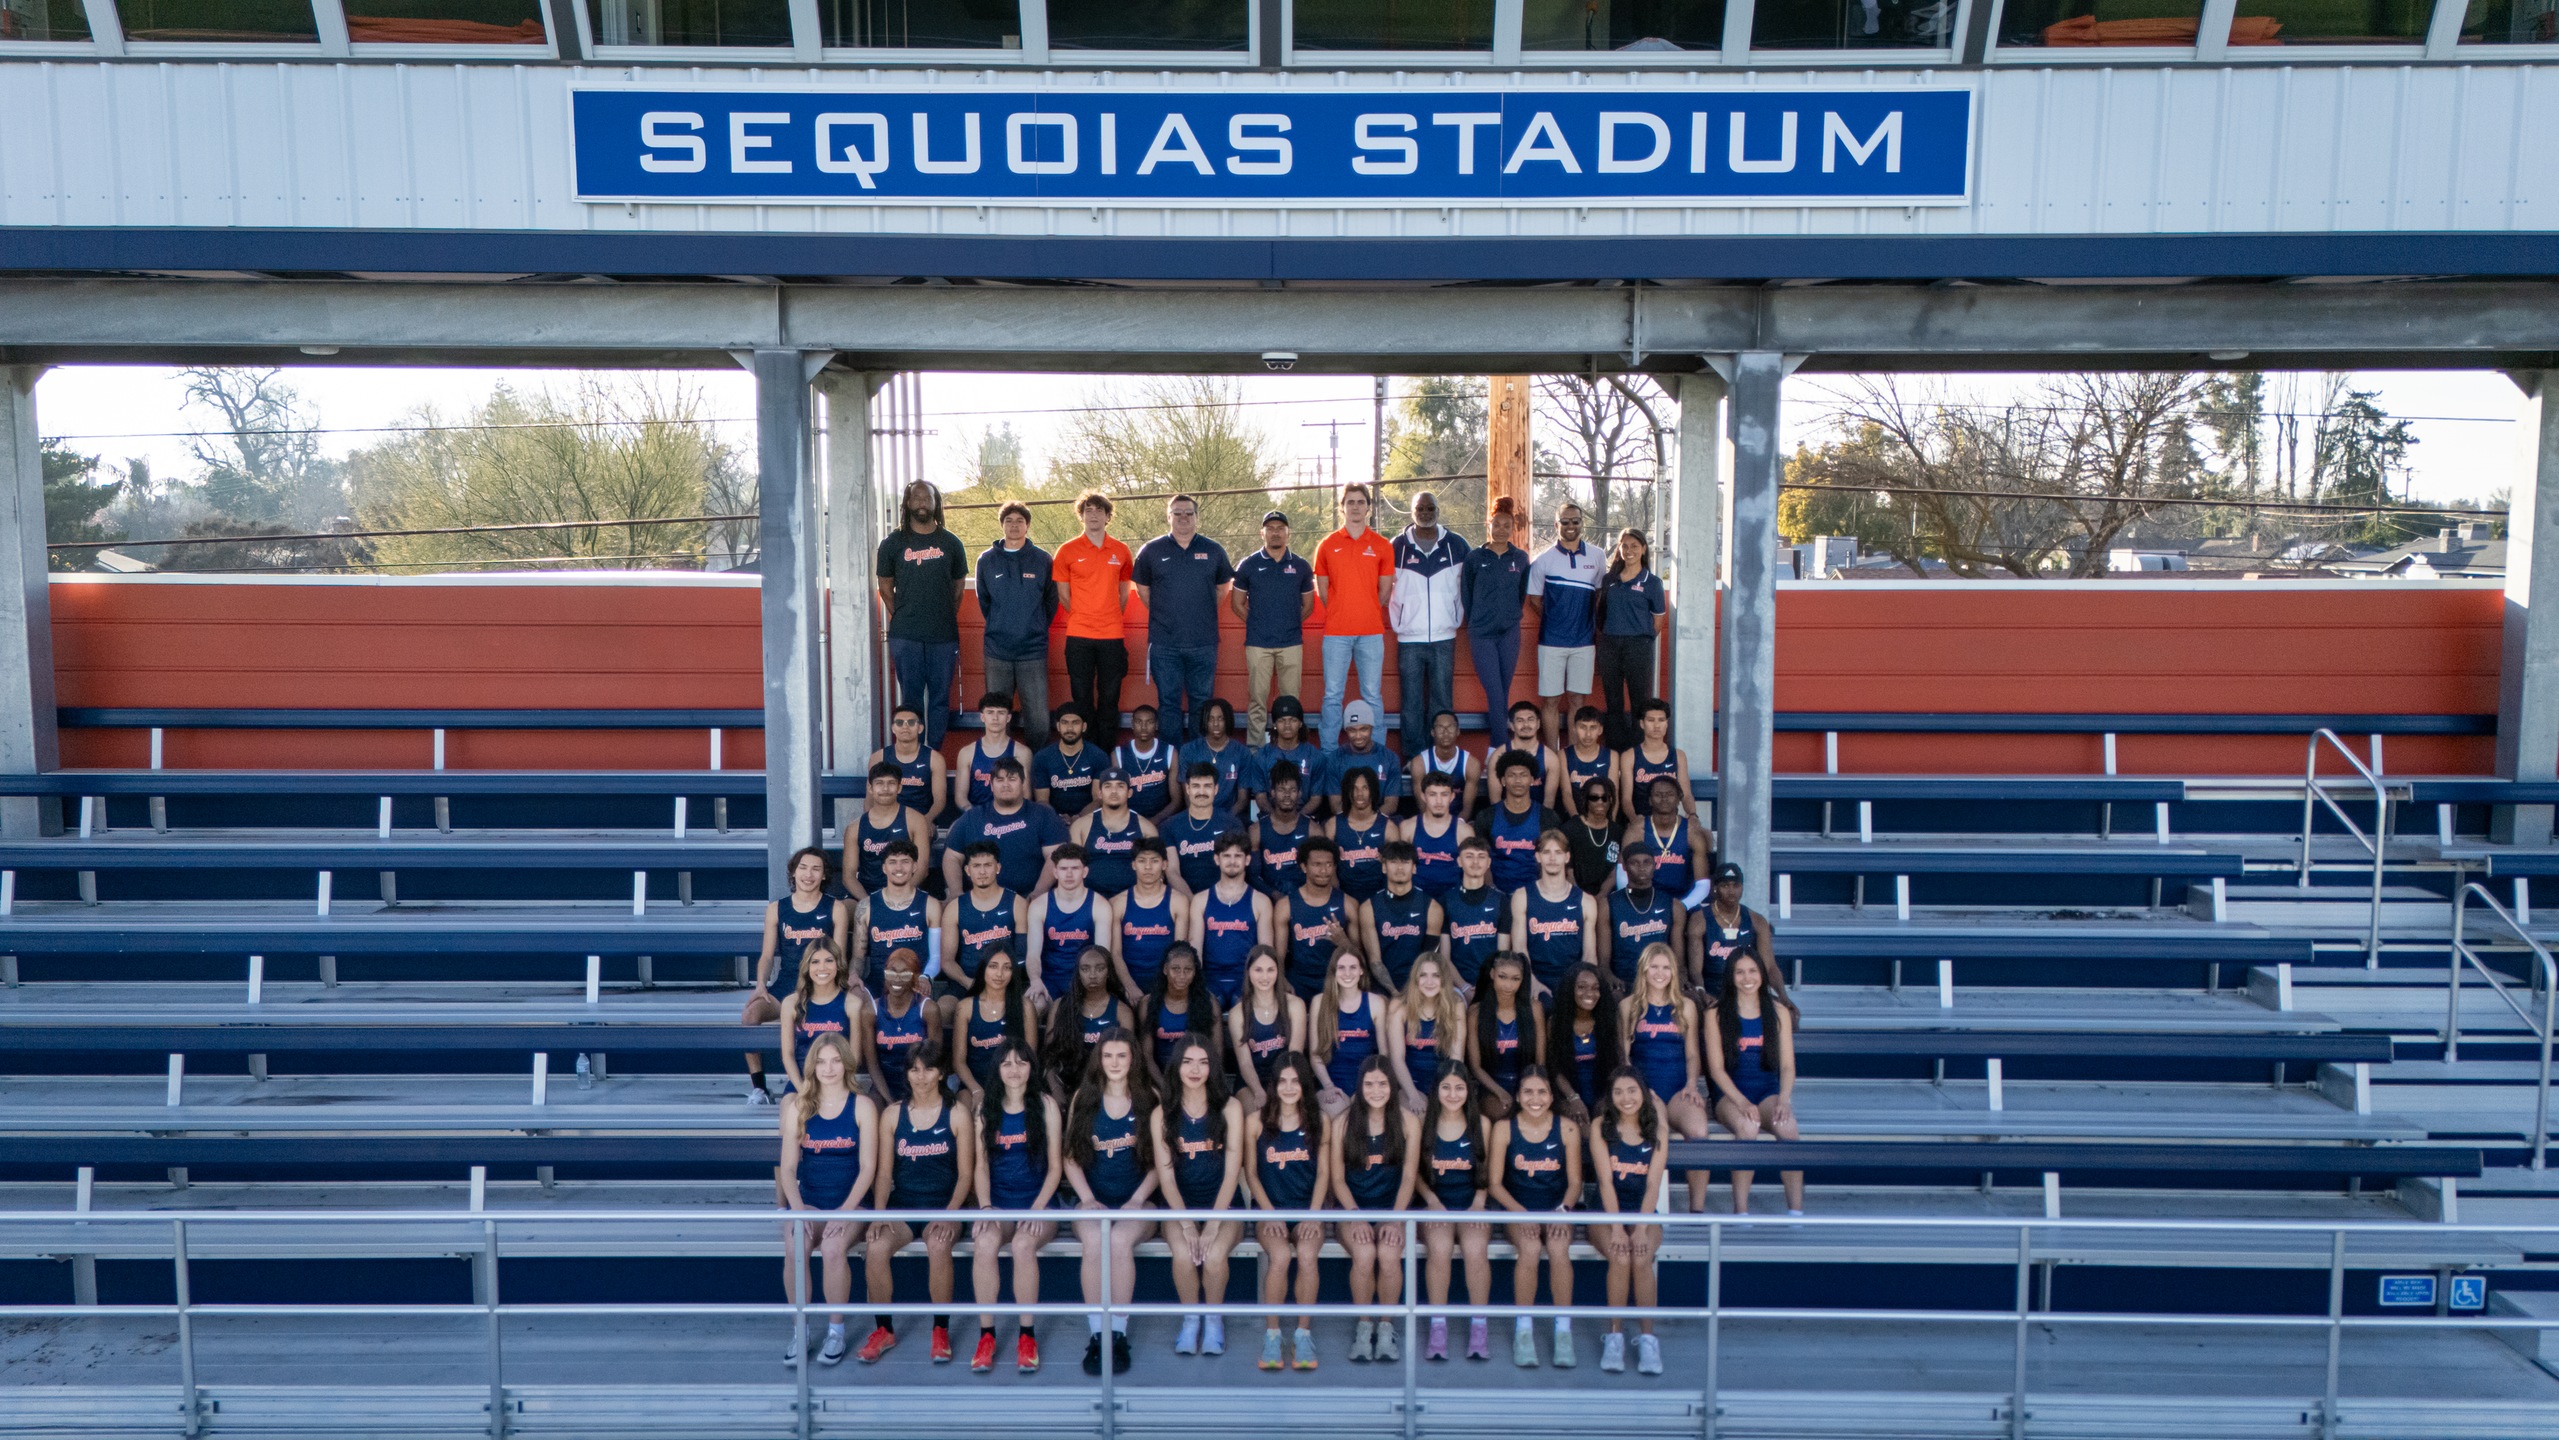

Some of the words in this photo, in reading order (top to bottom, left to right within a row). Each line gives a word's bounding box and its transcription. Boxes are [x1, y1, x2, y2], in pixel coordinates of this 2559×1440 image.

[639, 111, 1293, 189] SEQUOIAS
[1350, 111, 1904, 175] STADIUM
[904, 546, 944, 565] Sequoias
[1051, 775, 1092, 791] Sequoias
[1130, 770, 1165, 791] equoias
[984, 820, 1026, 838] Sequoias
[1180, 840, 1214, 857] Sequoi
[1496, 836, 1536, 854] Sequoias
[1264, 848, 1296, 870] Sequoi
[784, 927, 824, 944] Sequoias
[871, 925, 922, 947] Sequoias
[1208, 917, 1248, 936] Sequoias
[1382, 921, 1420, 940] Sequoias
[1450, 921, 1497, 944] Sequoias
[1529, 917, 1579, 941] Sequoias
[1620, 920, 1667, 941] Sequoias
[963, 926, 1011, 949] Sequoias
[1048, 927, 1089, 946] Sequoias
[796, 1021, 843, 1037] equoias
[877, 1032, 922, 1050] Sequoias
[898, 1139, 948, 1161] Sequoias
[1432, 1155, 1472, 1175] equoias
[1515, 1154, 1560, 1177] Sequoias
